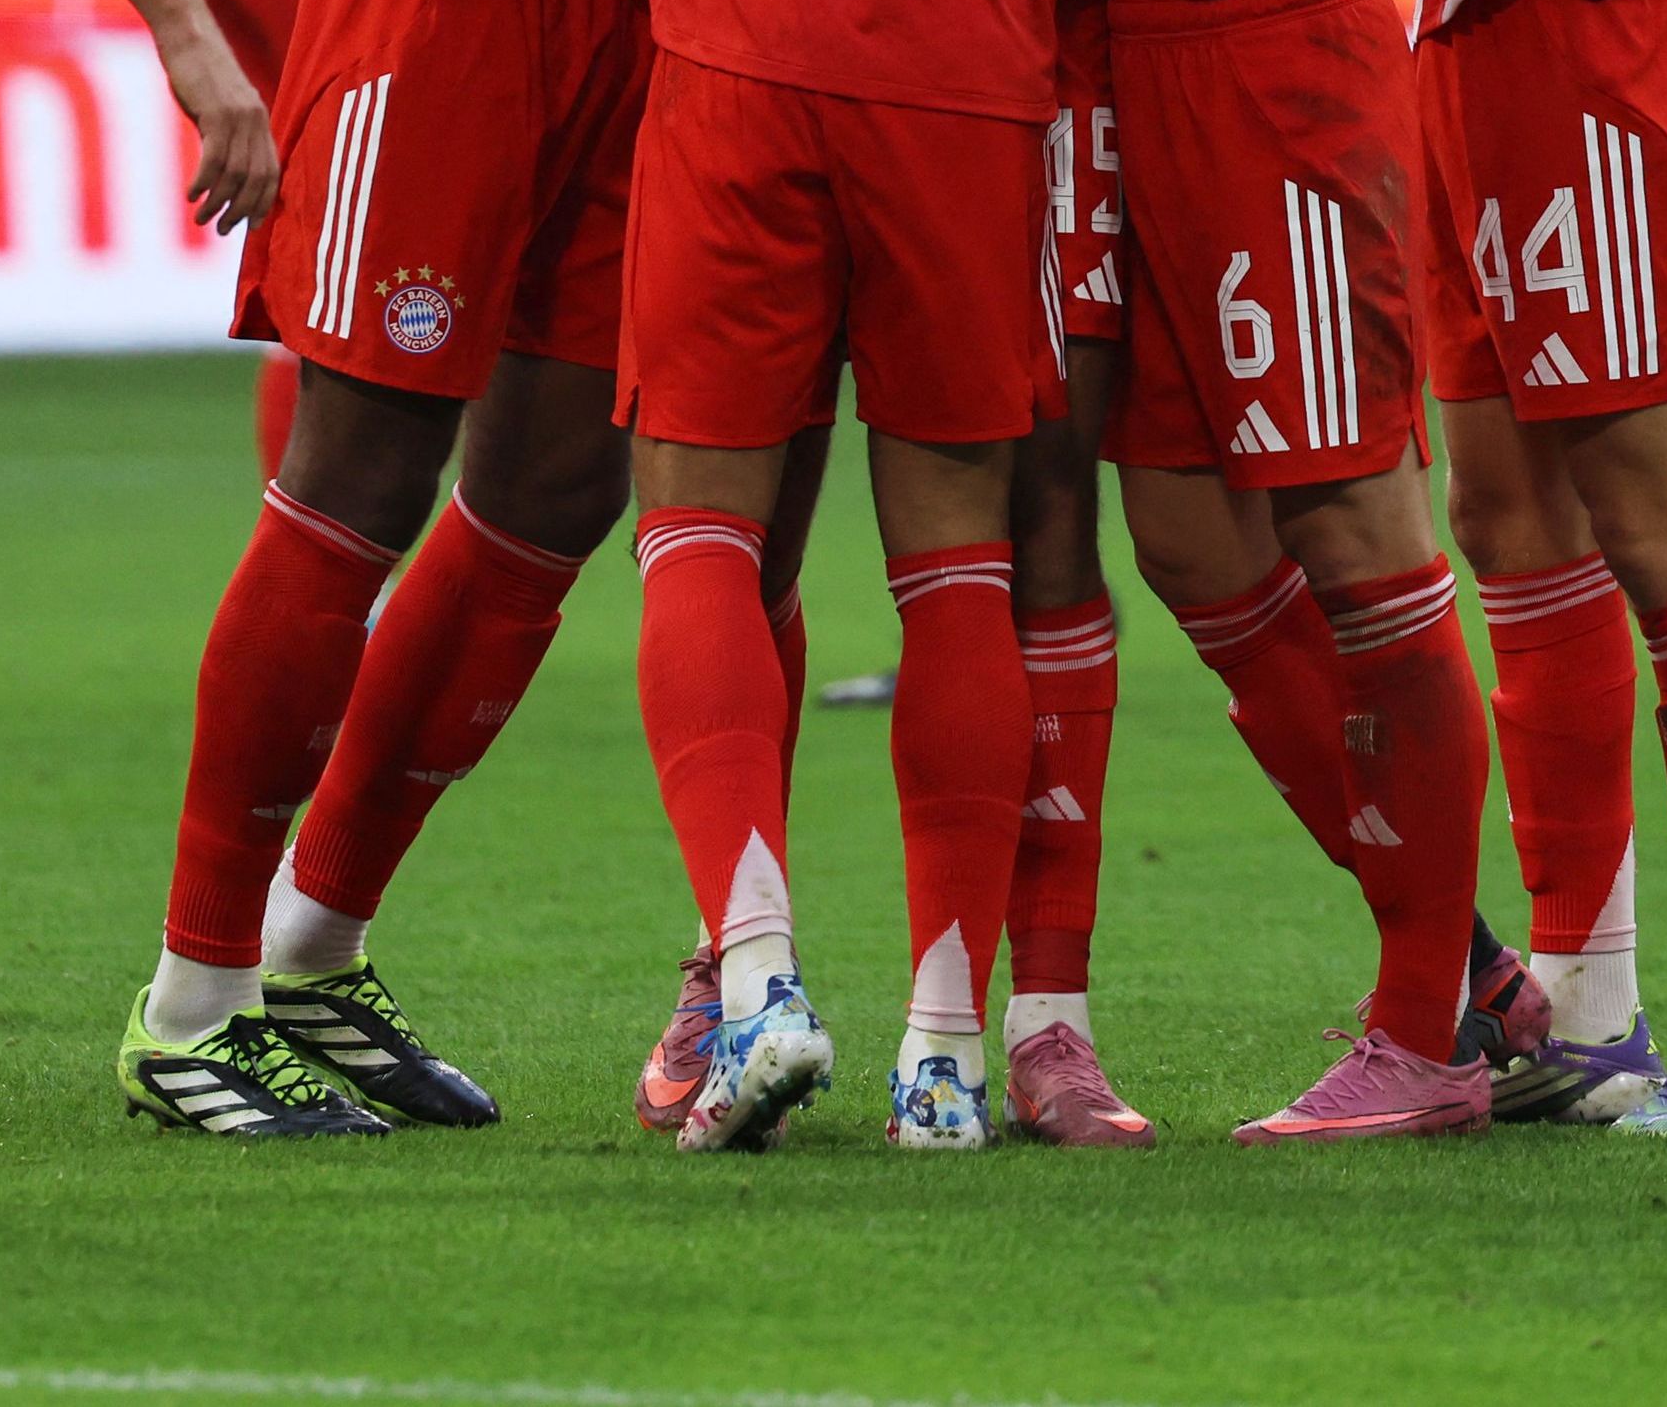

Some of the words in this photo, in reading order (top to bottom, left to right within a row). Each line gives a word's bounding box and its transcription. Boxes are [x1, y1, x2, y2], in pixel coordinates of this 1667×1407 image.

[392, 296, 407, 312] FC
[407, 290, 447, 319] BAYERN
[1217, 251, 1275, 379] 6
[1473, 187, 1590, 322] 44
